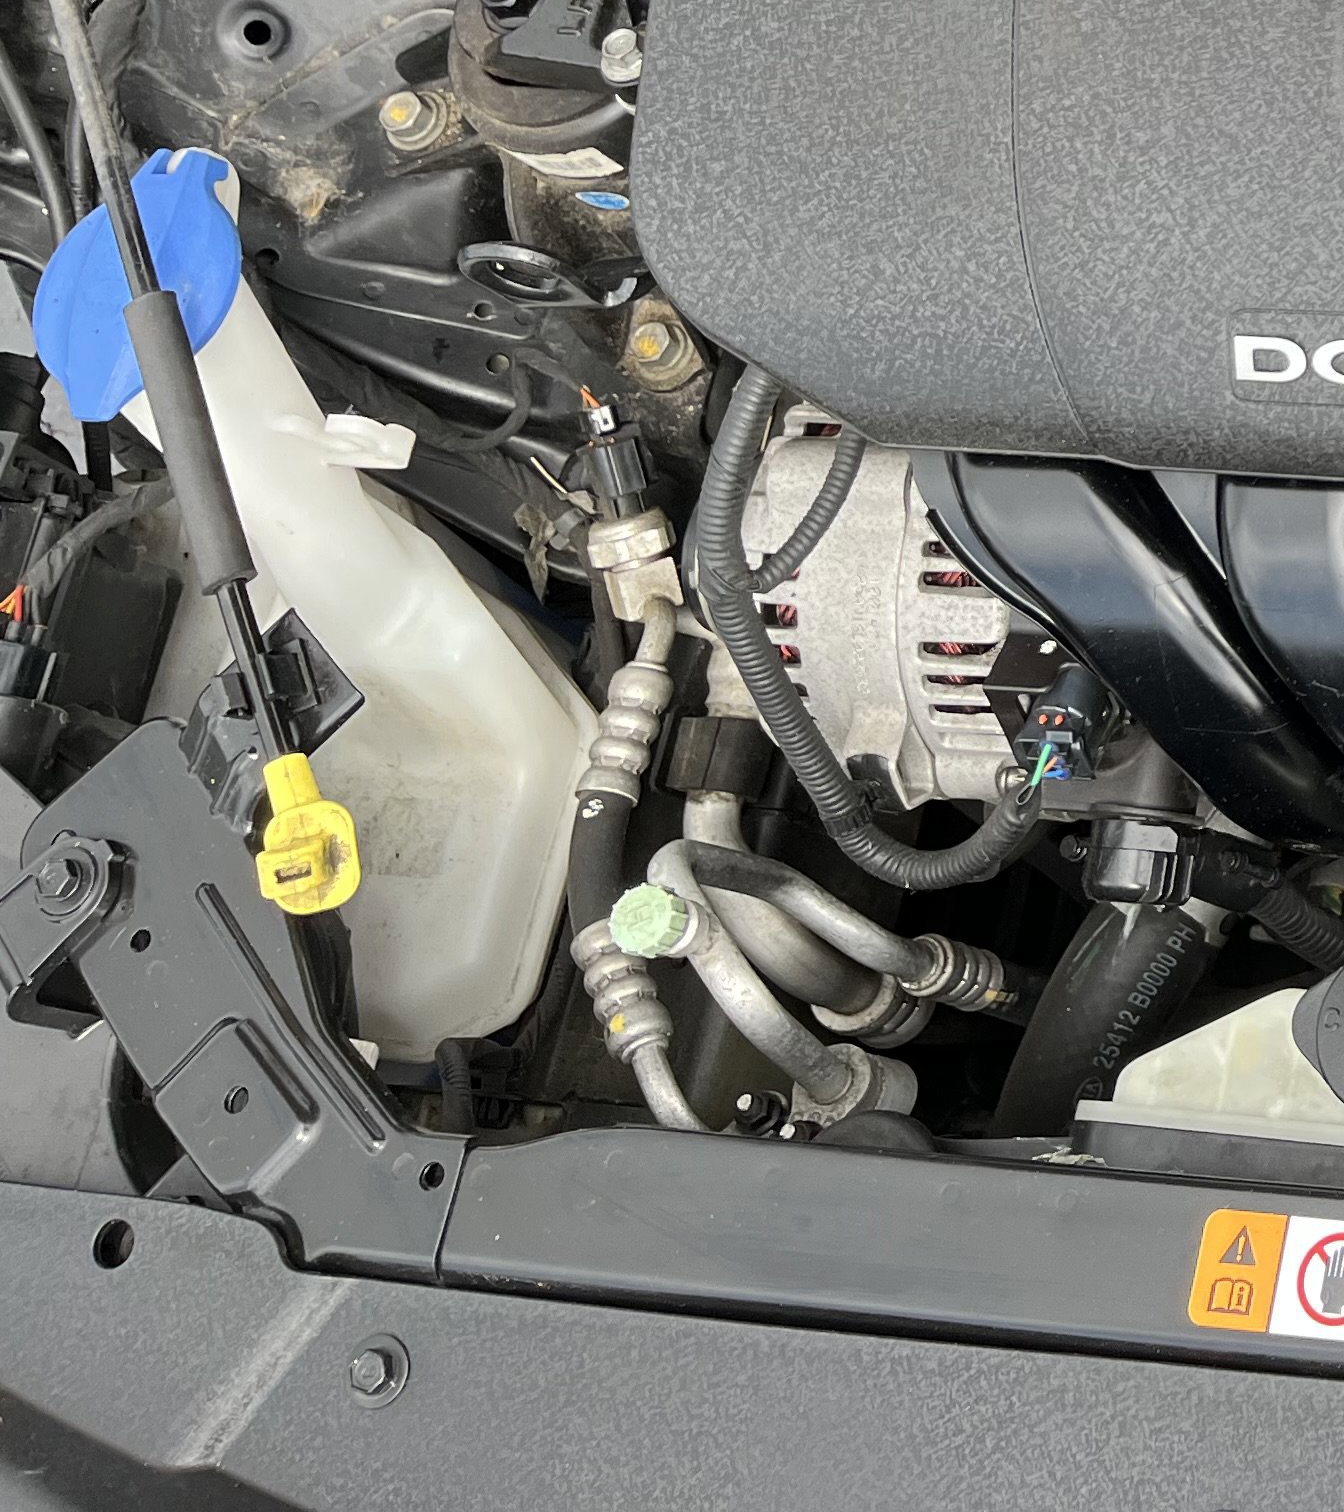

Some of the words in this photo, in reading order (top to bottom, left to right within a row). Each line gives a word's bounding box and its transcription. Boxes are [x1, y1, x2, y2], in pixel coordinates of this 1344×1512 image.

[1092, 1010, 1141, 1070] 25412
[1127, 951, 1179, 1009] B0000
[1166, 922, 1197, 954] PH
